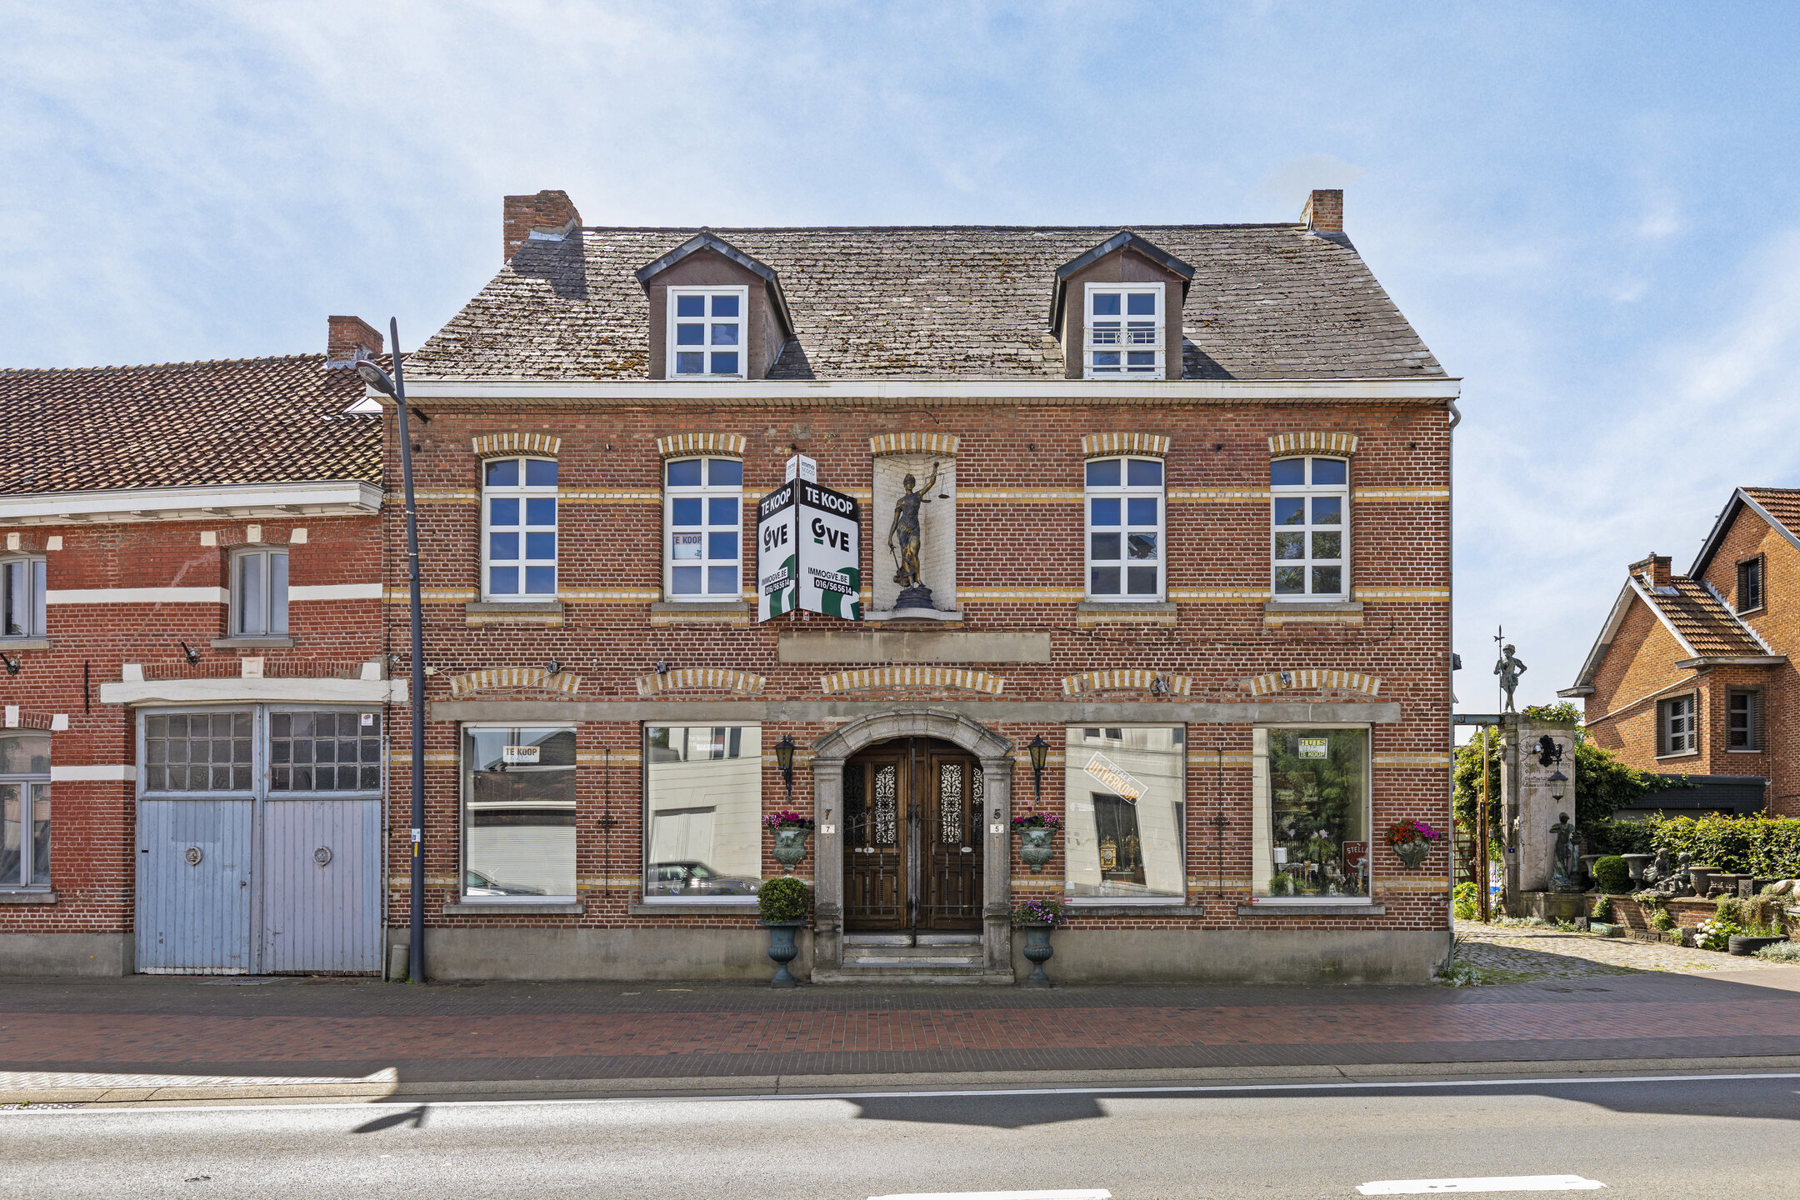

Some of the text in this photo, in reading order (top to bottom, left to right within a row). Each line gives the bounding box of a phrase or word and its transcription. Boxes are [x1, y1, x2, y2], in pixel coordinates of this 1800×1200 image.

[761, 488, 791, 516] TE KOOP
[805, 486, 853, 514] TE KOOP
[764, 523, 787, 548] GVE
[811, 517, 849, 552] GVE
[761, 569, 787, 585] IMMOGVE.BE
[807, 566, 848, 584] IMMOGVE.BE
[765, 578, 790, 595] 016/565614
[815, 580, 852, 595] 016/565614
[517, 747, 538, 755] KOOP
[1088, 760, 1140, 801] UITVERKOOP
[825, 808, 832, 820] 7
[994, 808, 1001, 820] 5
